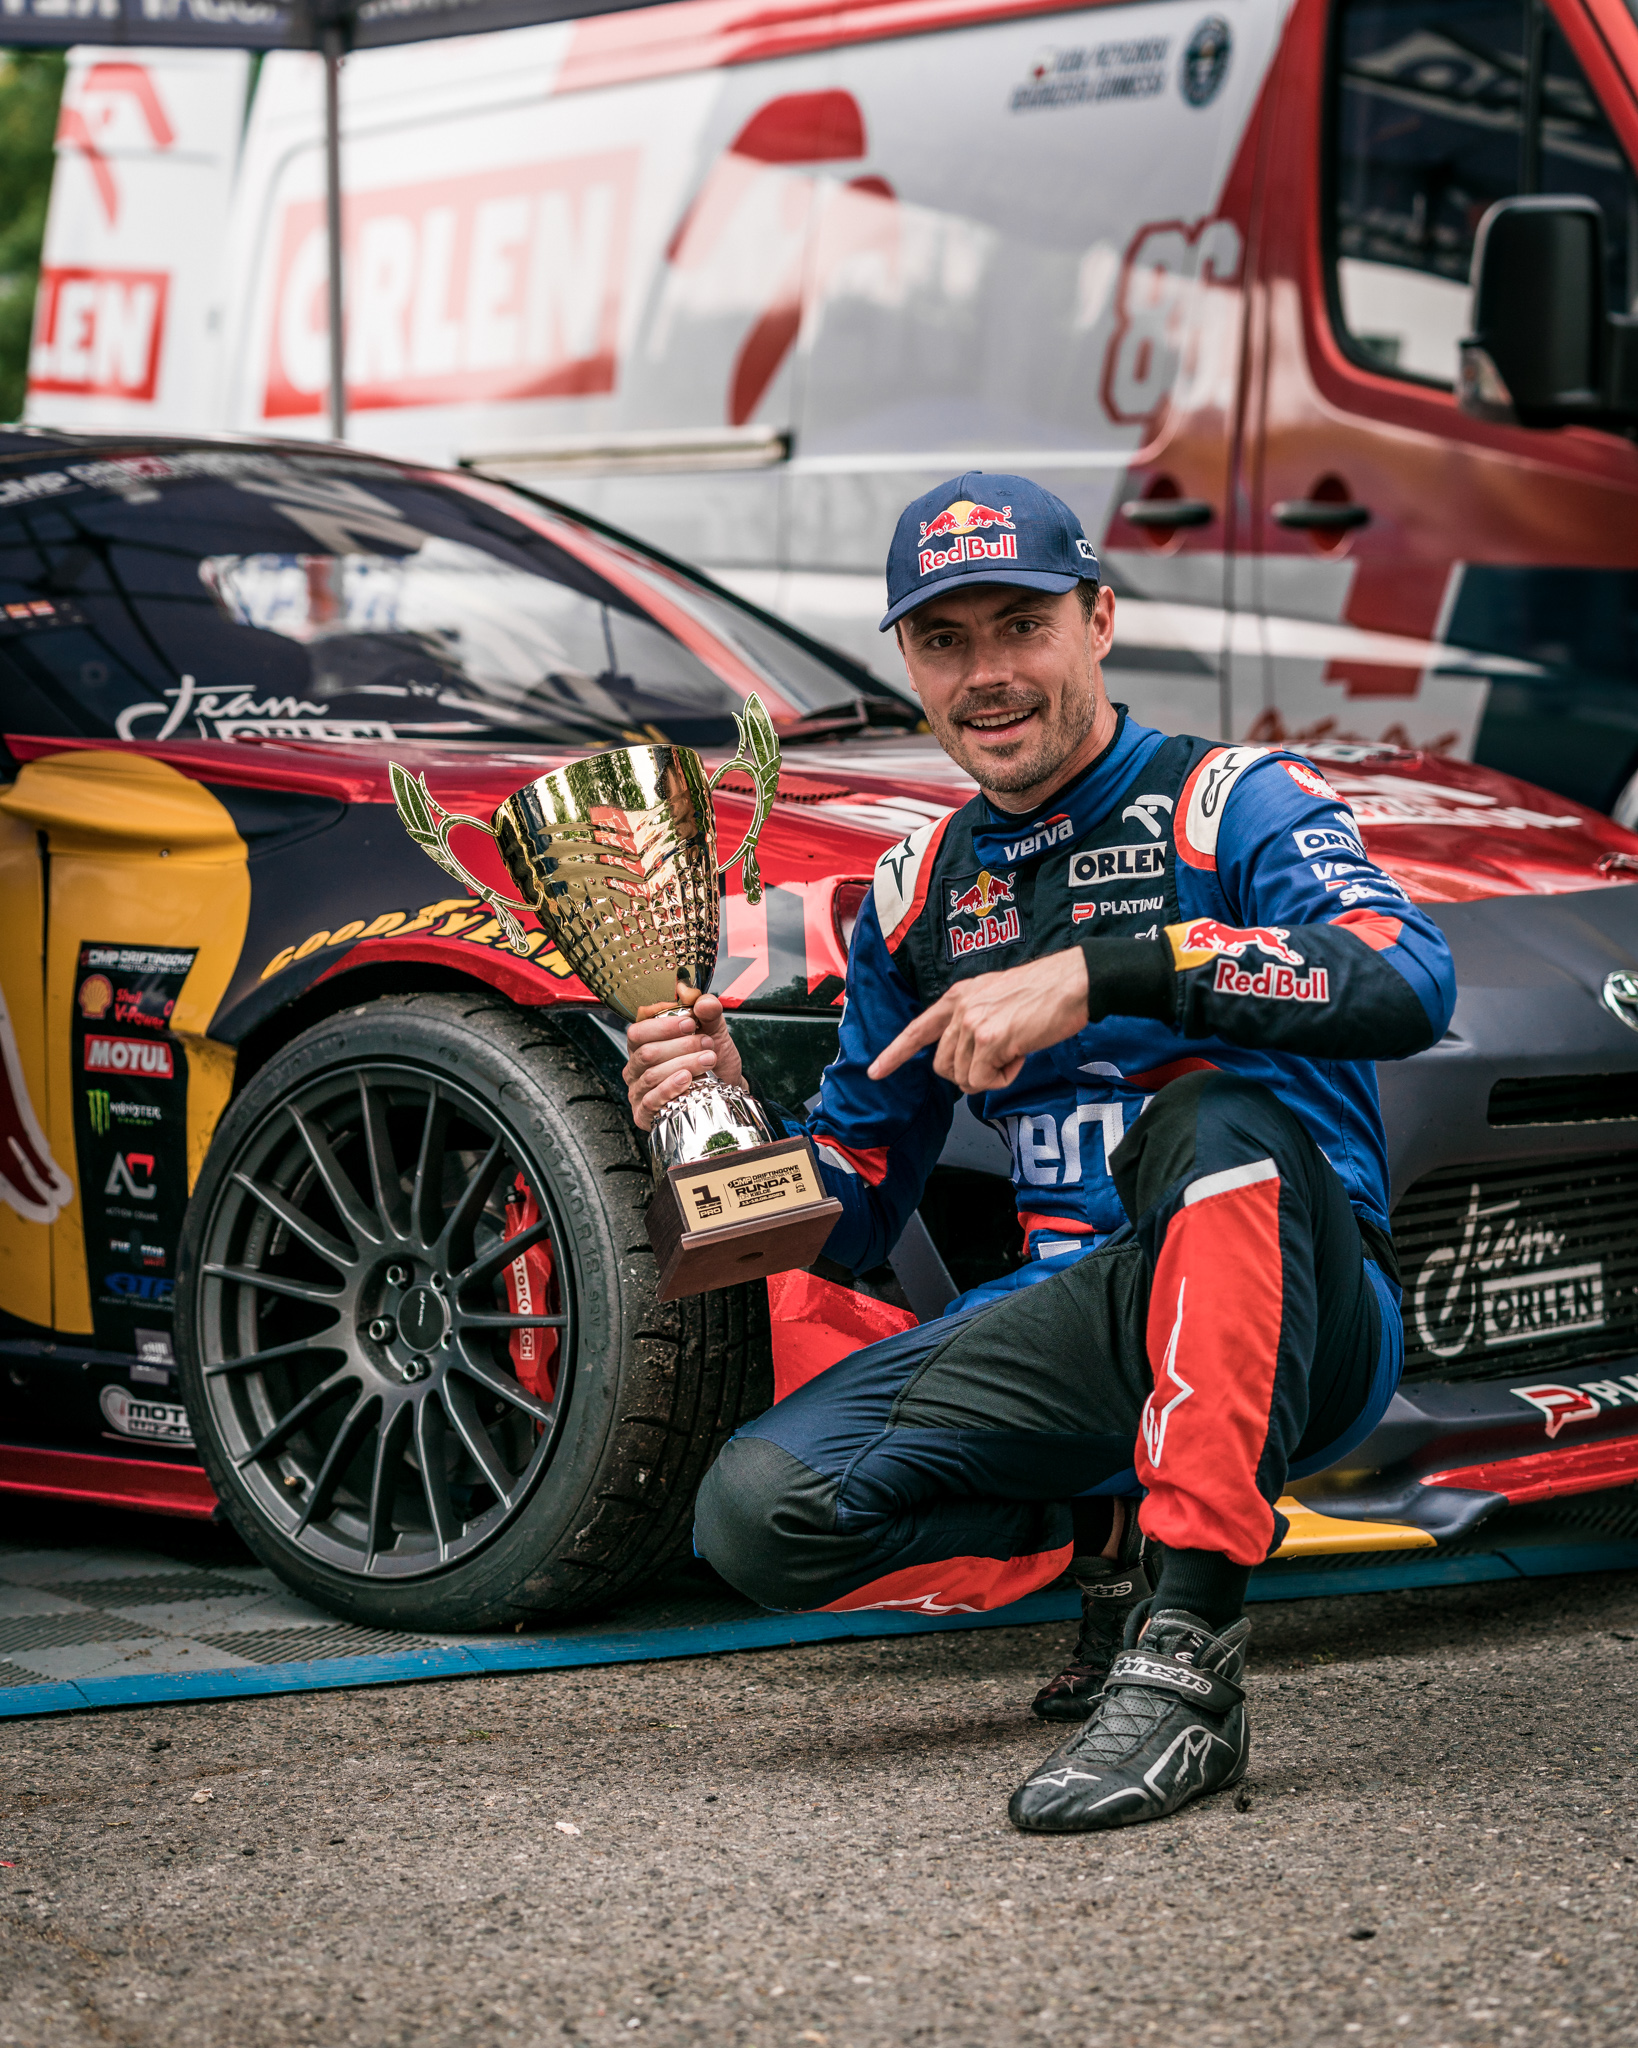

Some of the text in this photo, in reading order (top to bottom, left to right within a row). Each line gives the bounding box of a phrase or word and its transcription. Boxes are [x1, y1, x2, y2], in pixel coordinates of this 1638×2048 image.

[279, 182, 615, 396] ORLEN
[1003, 818, 1075, 862] verva
[88, 1040, 170, 1074] MOTUL
[692, 1185, 721, 1206] 1
[735, 1177, 790, 1196] RUNDA
[792, 1173, 802, 1182] 2
[700, 1207, 721, 1218] PRO
